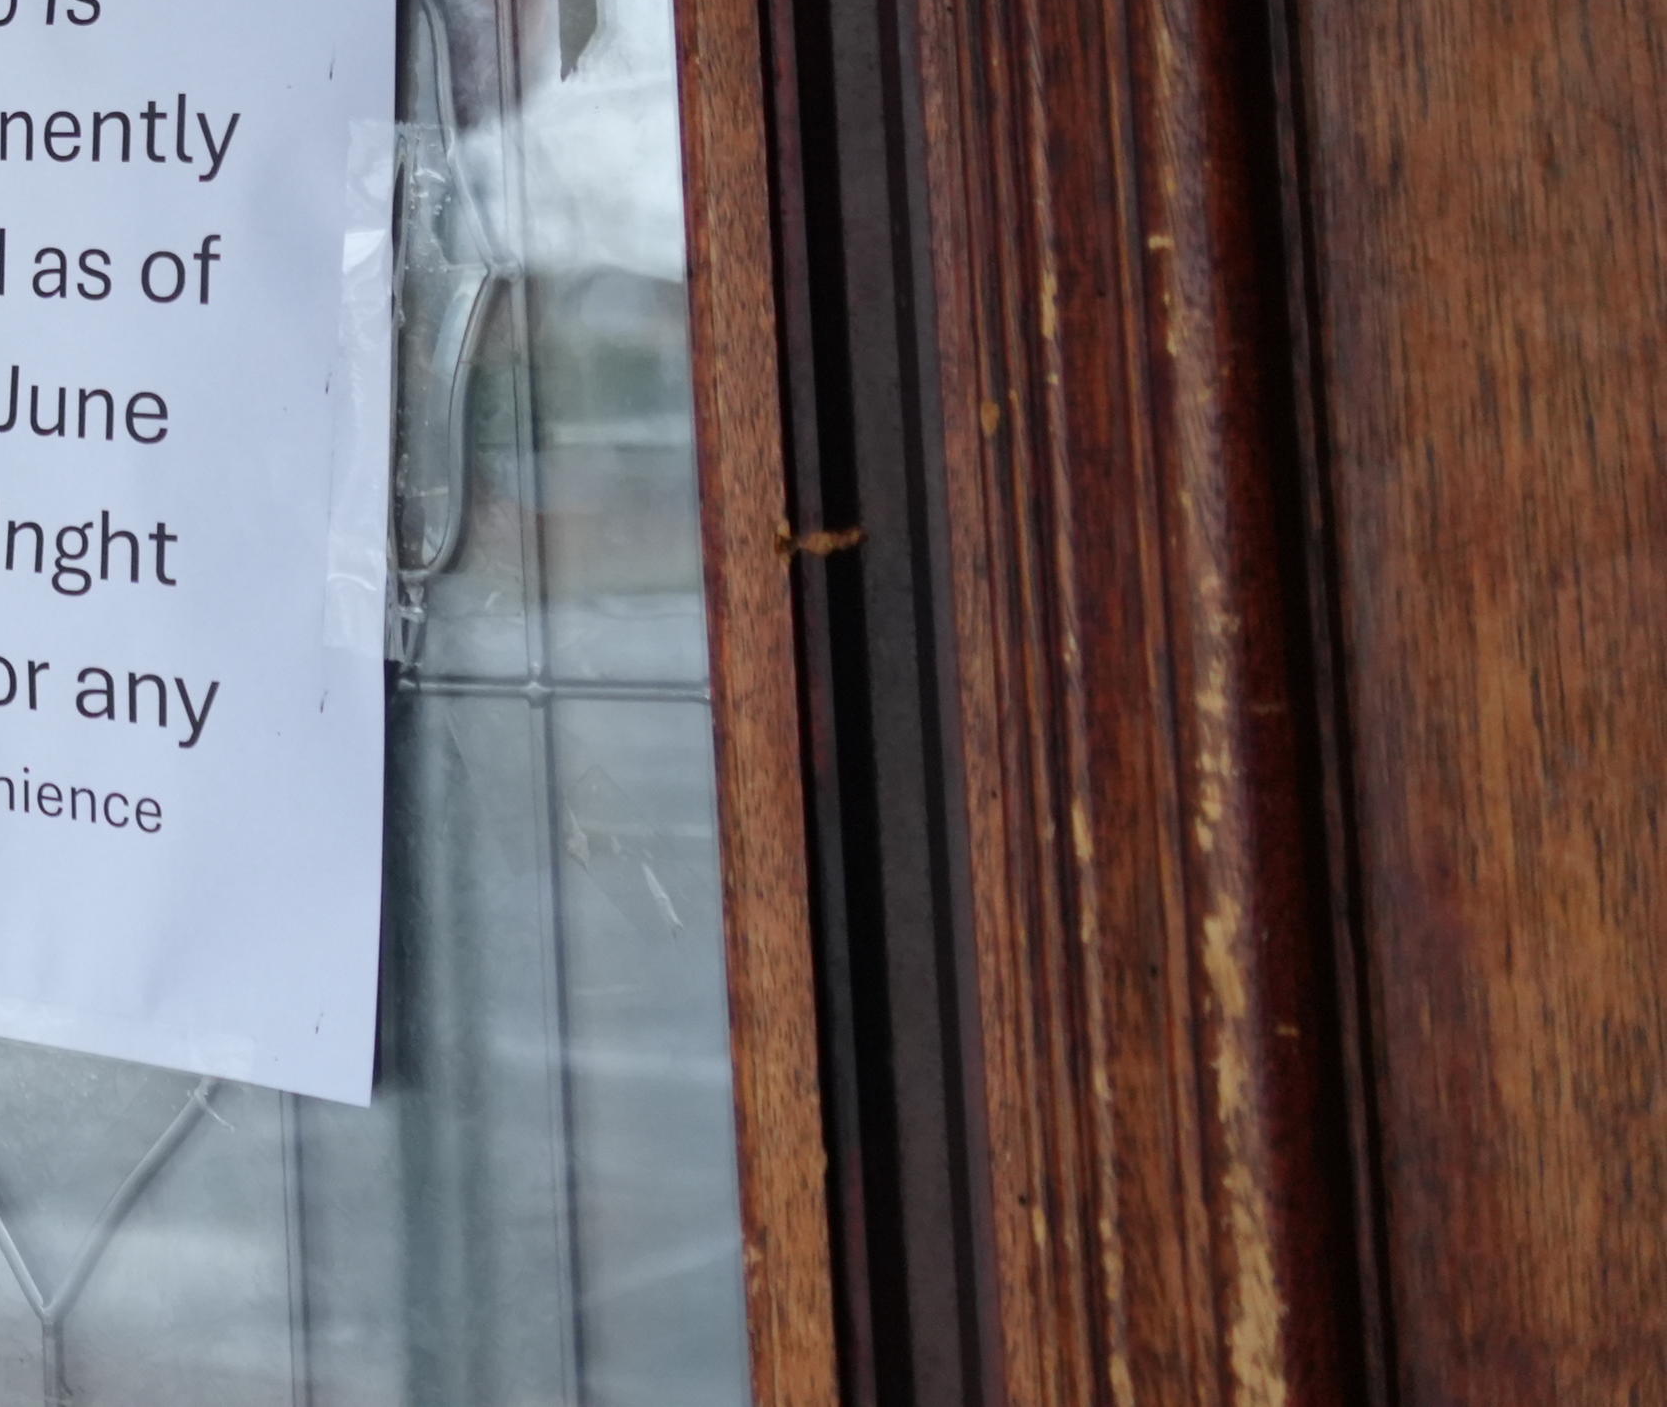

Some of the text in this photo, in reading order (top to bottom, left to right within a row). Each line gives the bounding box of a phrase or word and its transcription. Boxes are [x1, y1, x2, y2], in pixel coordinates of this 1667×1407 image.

[31, 240, 113, 303] as
[141, 234, 222, 306] of
[75, 665, 220, 748] any
